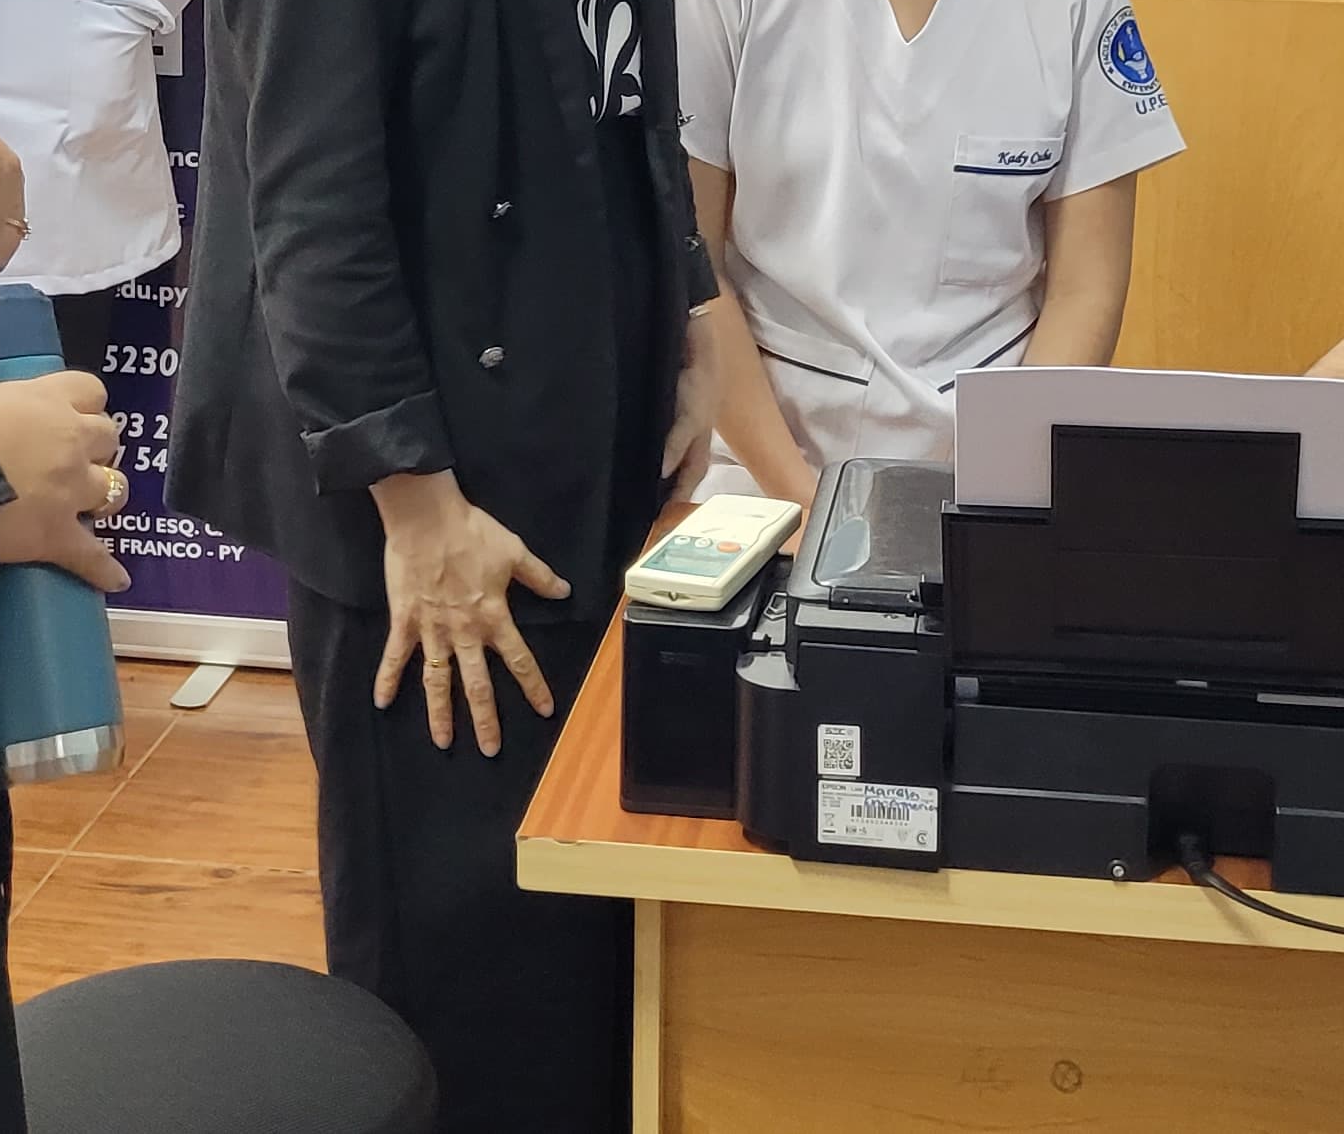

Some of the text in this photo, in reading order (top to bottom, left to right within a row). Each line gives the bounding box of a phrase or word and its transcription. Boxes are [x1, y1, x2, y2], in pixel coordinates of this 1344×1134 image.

[116, 278, 190, 309] du.py
[102, 344, 180, 378] 5230
[156, 517, 200, 539] ESQ.
[119, 538, 202, 560] FRANCO
[218, 544, 247, 563] PY
